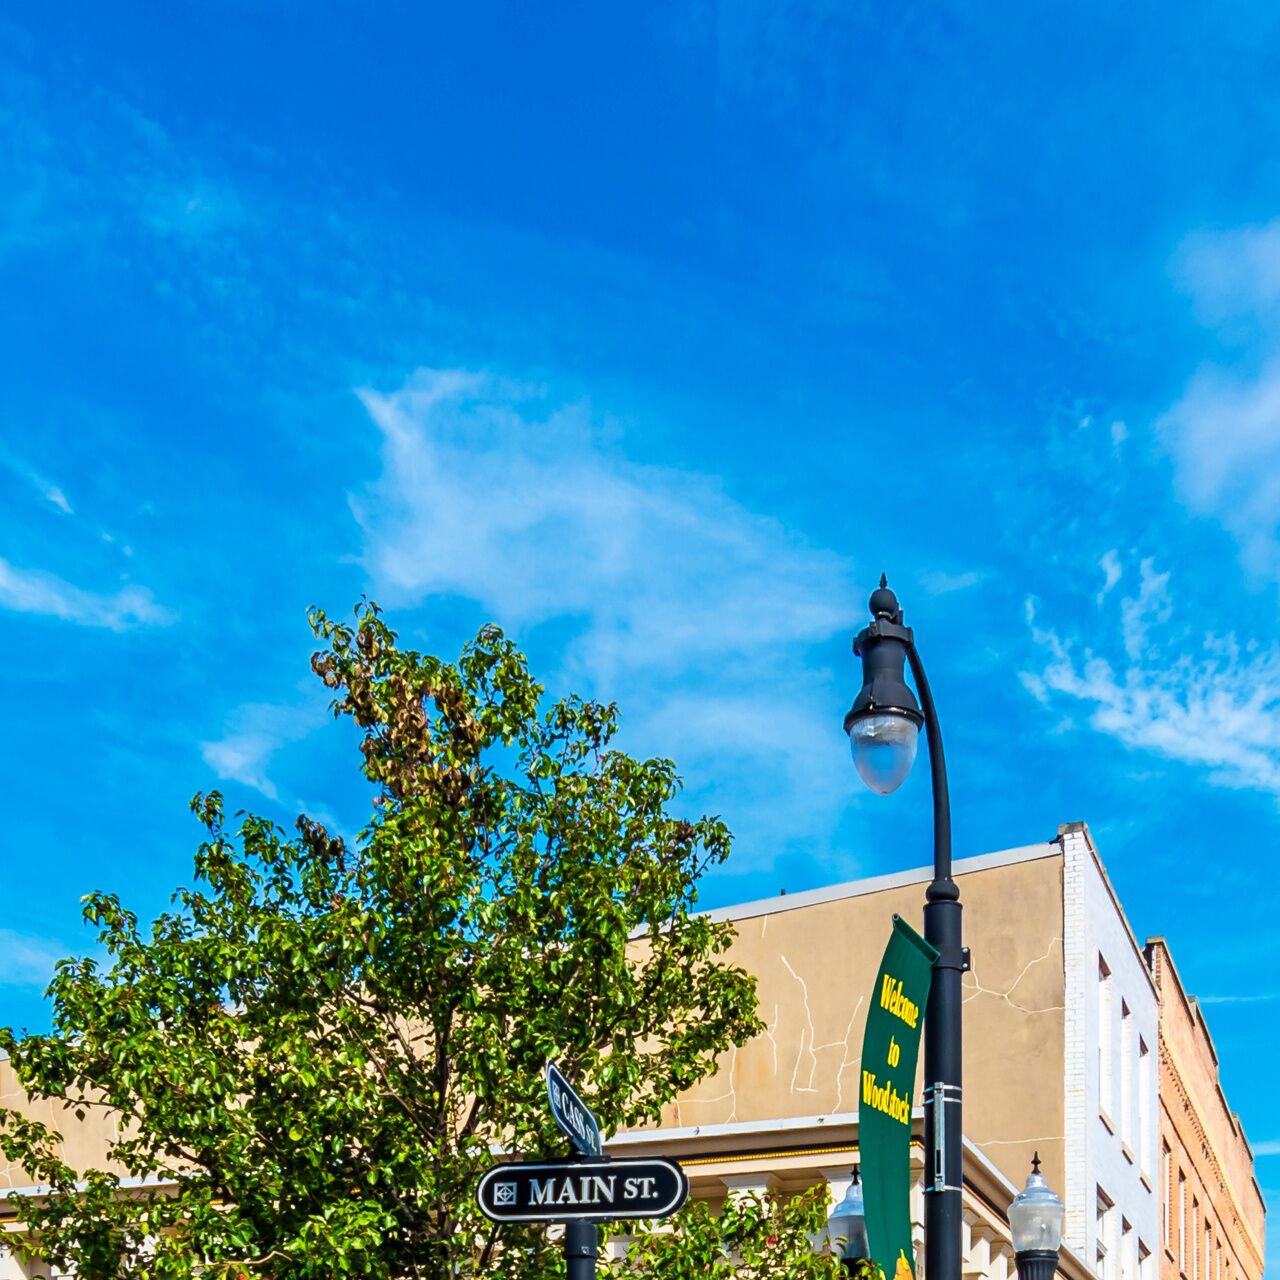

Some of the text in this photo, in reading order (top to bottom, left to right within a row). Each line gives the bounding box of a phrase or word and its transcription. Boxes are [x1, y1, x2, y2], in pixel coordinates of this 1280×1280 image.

[880, 973, 919, 1029] Welcome
[887, 1034, 901, 1068] to
[562, 1091, 586, 1140] CASS
[862, 1070, 910, 1126] Woodstock
[528, 1175, 659, 1206] MAIN ST.
